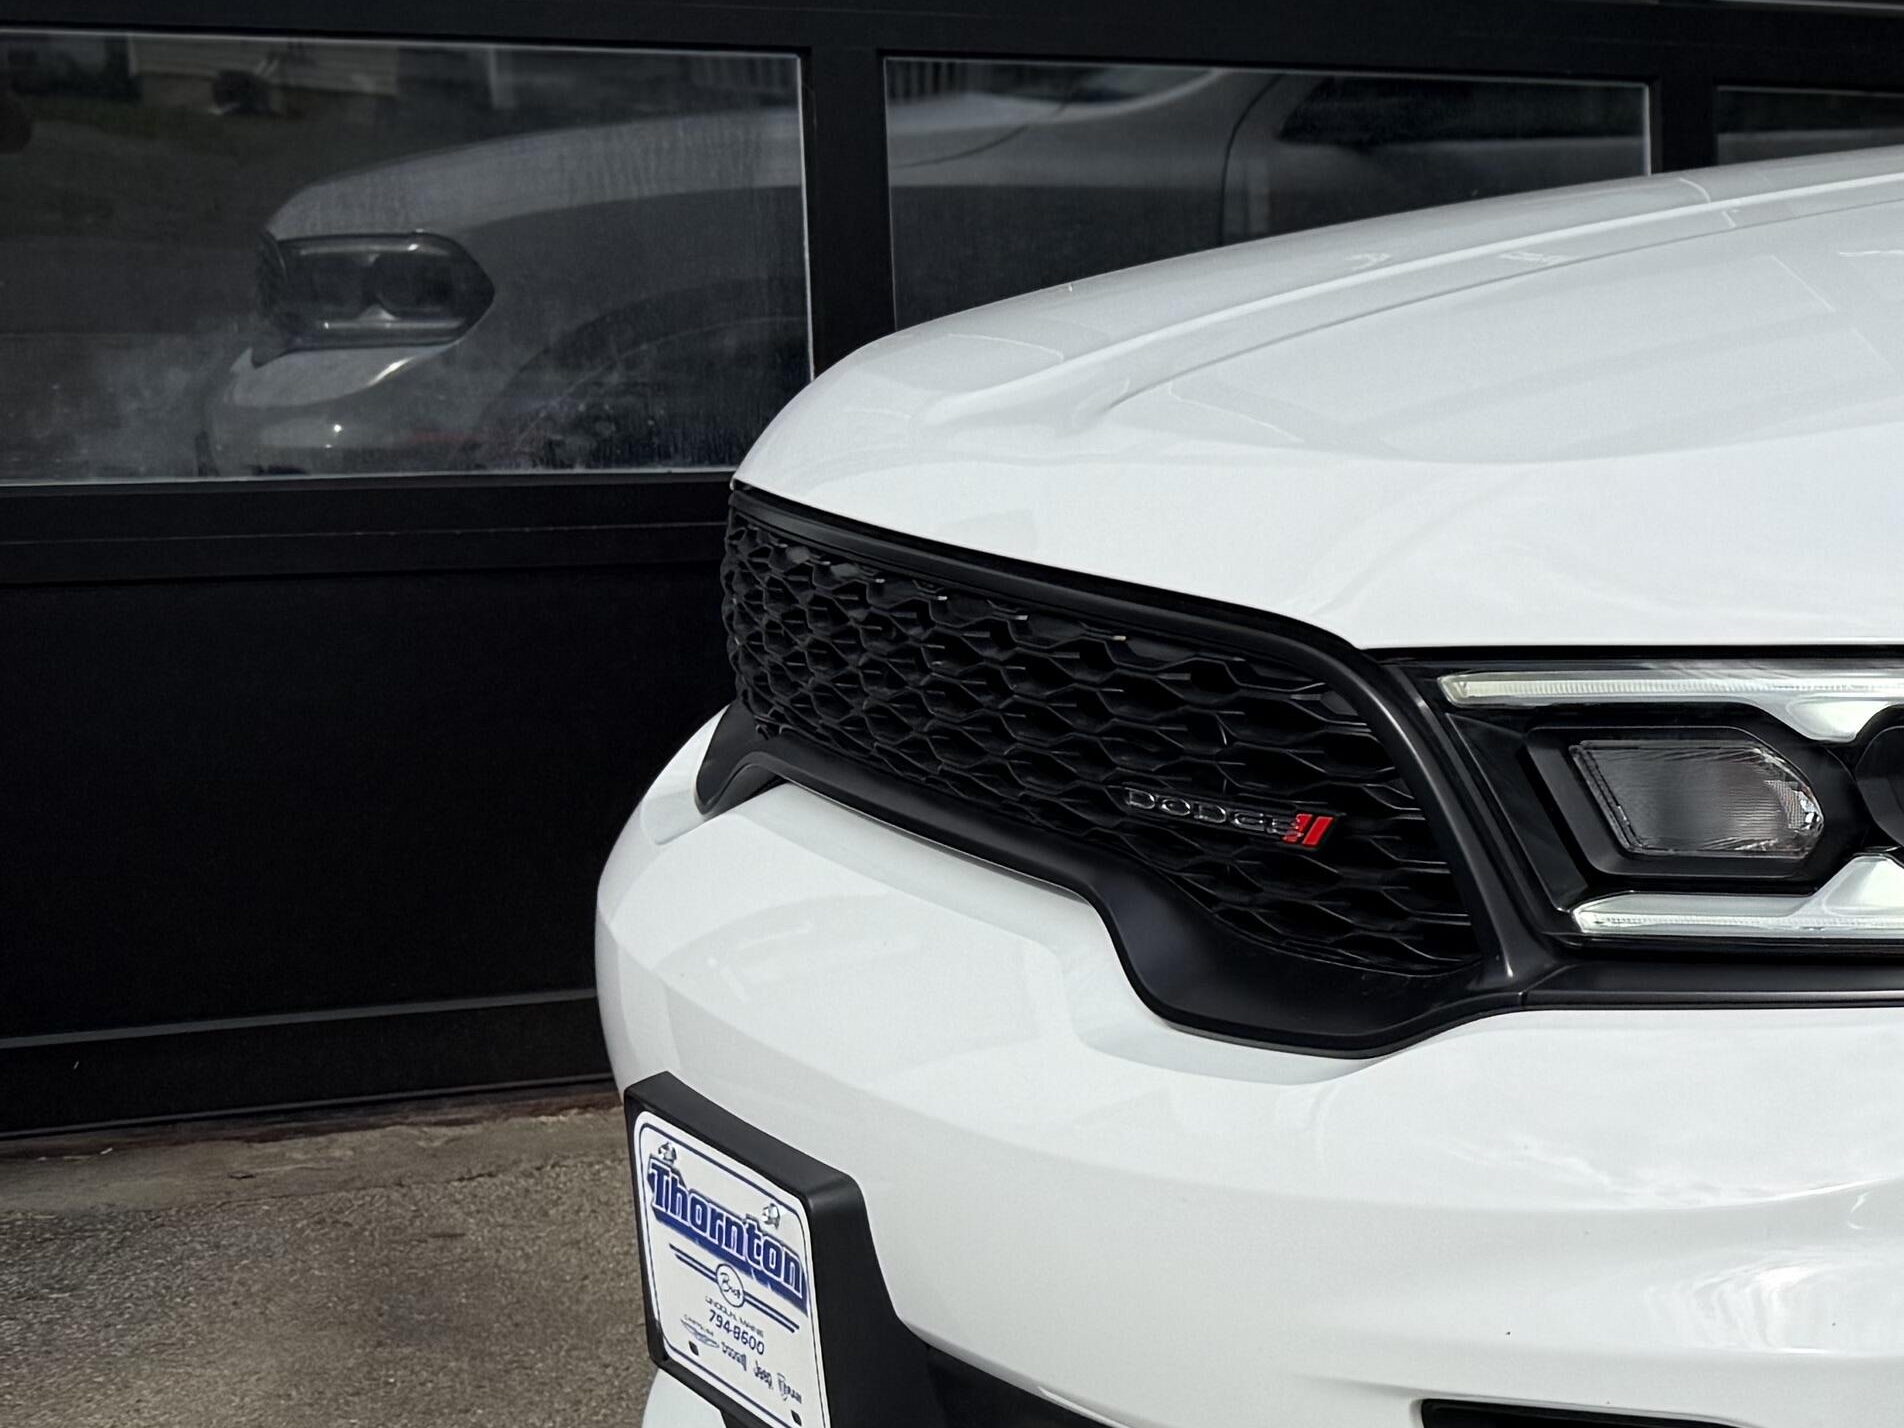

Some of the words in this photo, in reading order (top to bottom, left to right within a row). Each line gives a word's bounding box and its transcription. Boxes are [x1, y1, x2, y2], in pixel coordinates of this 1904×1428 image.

[1125, 787, 1300, 836] DODGE
[650, 1157, 804, 1300] Thornton
[709, 1308, 765, 1355] 794-8600
